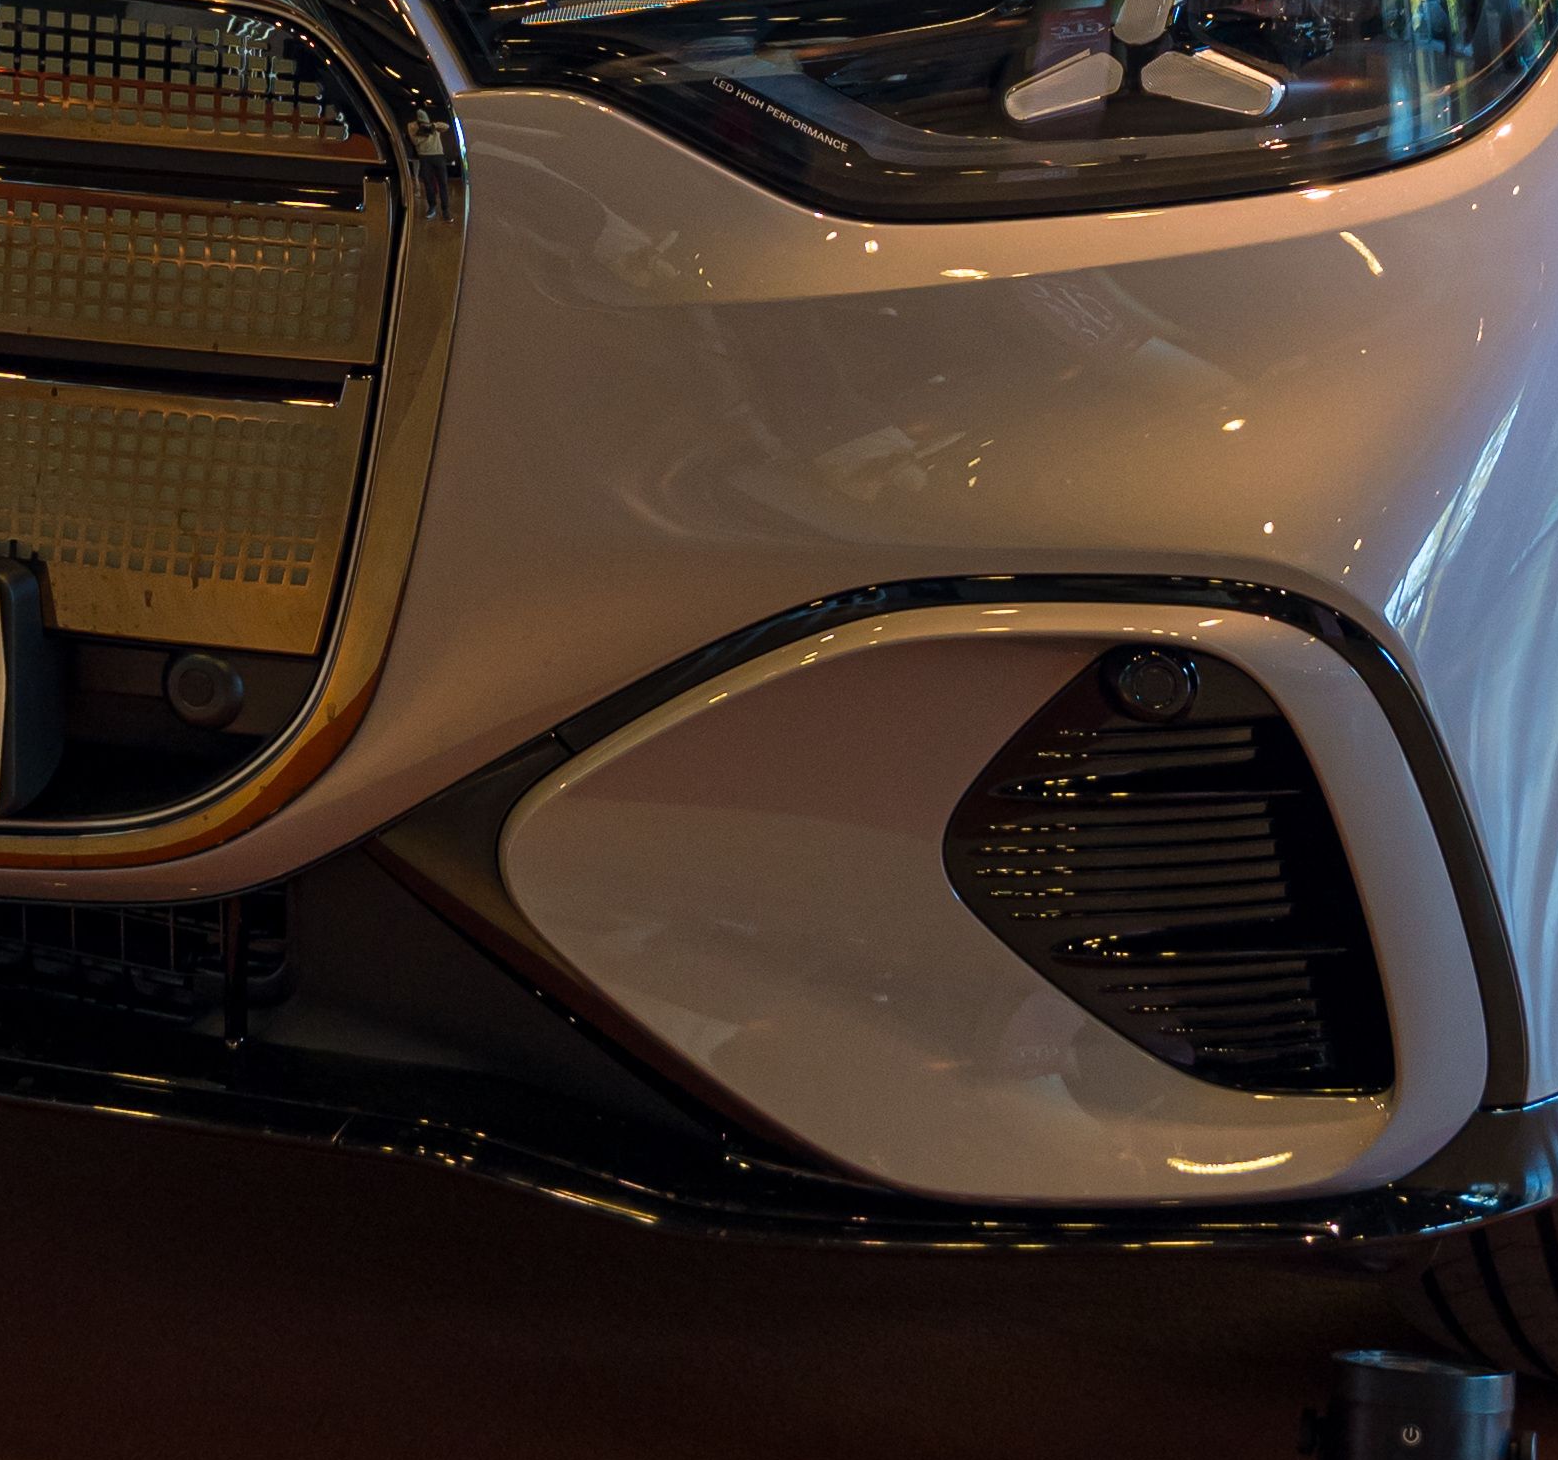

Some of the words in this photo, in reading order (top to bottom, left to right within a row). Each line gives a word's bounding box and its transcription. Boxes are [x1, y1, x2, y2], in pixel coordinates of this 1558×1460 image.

[712, 76, 734, 93] LED
[735, 88, 765, 110] HIGH
[766, 104, 849, 153] PERFORMANCE
